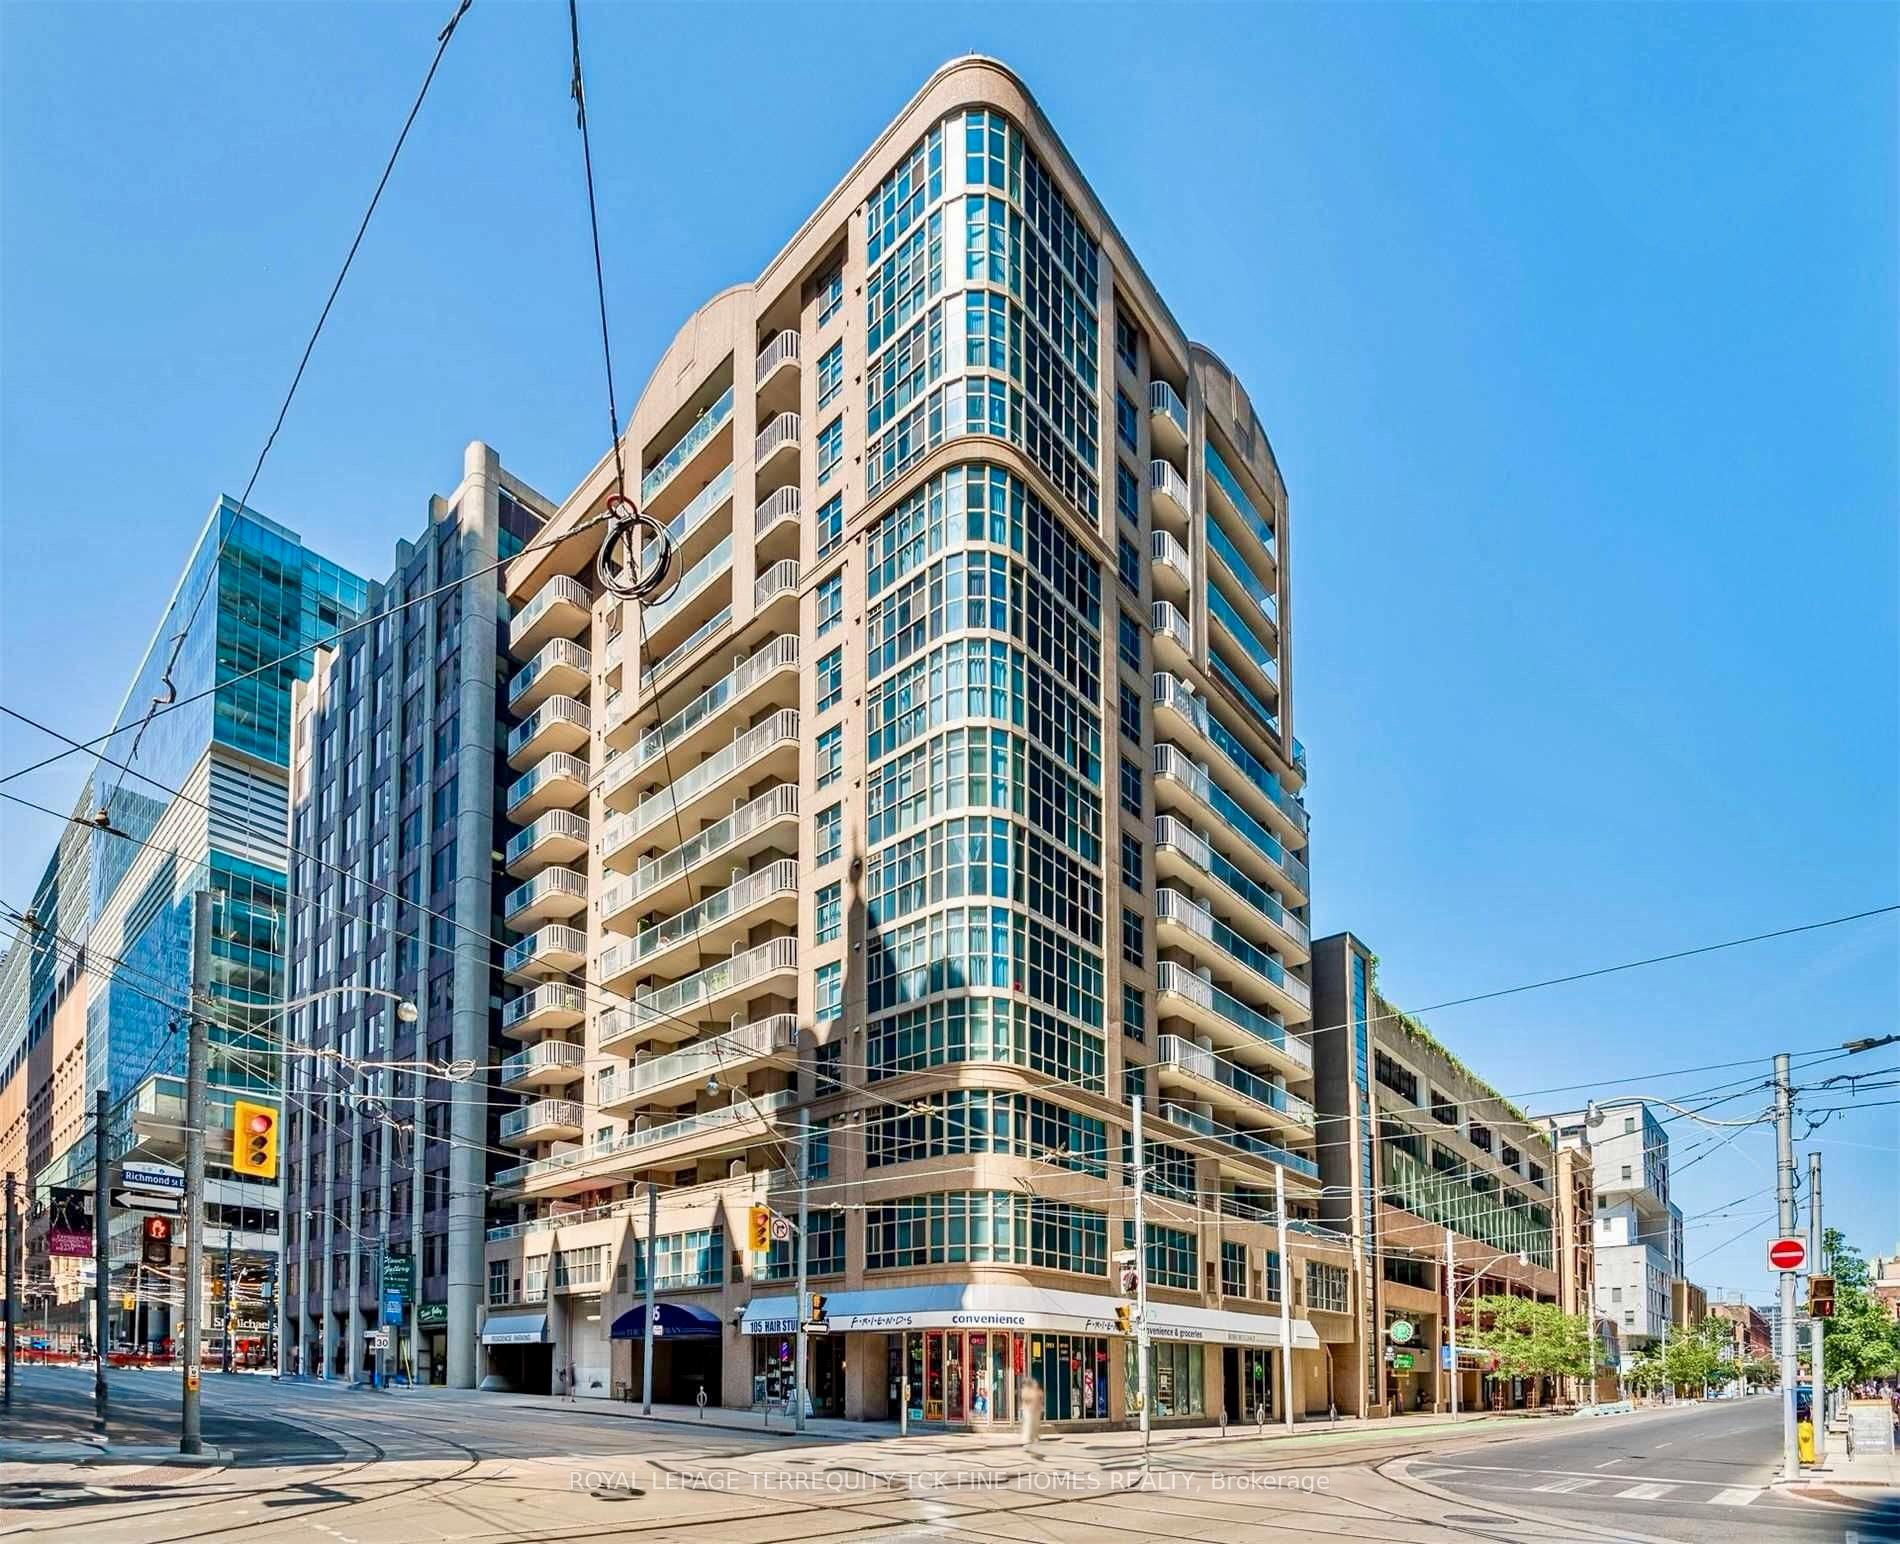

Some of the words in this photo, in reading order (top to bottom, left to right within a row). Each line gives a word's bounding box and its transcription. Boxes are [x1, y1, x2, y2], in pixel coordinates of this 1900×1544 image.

[125, 1171, 170, 1185] Richmond
[952, 1313, 1025, 1325] convenience
[750, 1321, 763, 1333] 105
[764, 1320, 781, 1333] HAIR
[1174, 1328, 1179, 1337] &
[1179, 1329, 1203, 1339] groceries
[376, 1339, 389, 1347] 30
[927, 1401, 944, 1416] ATM
